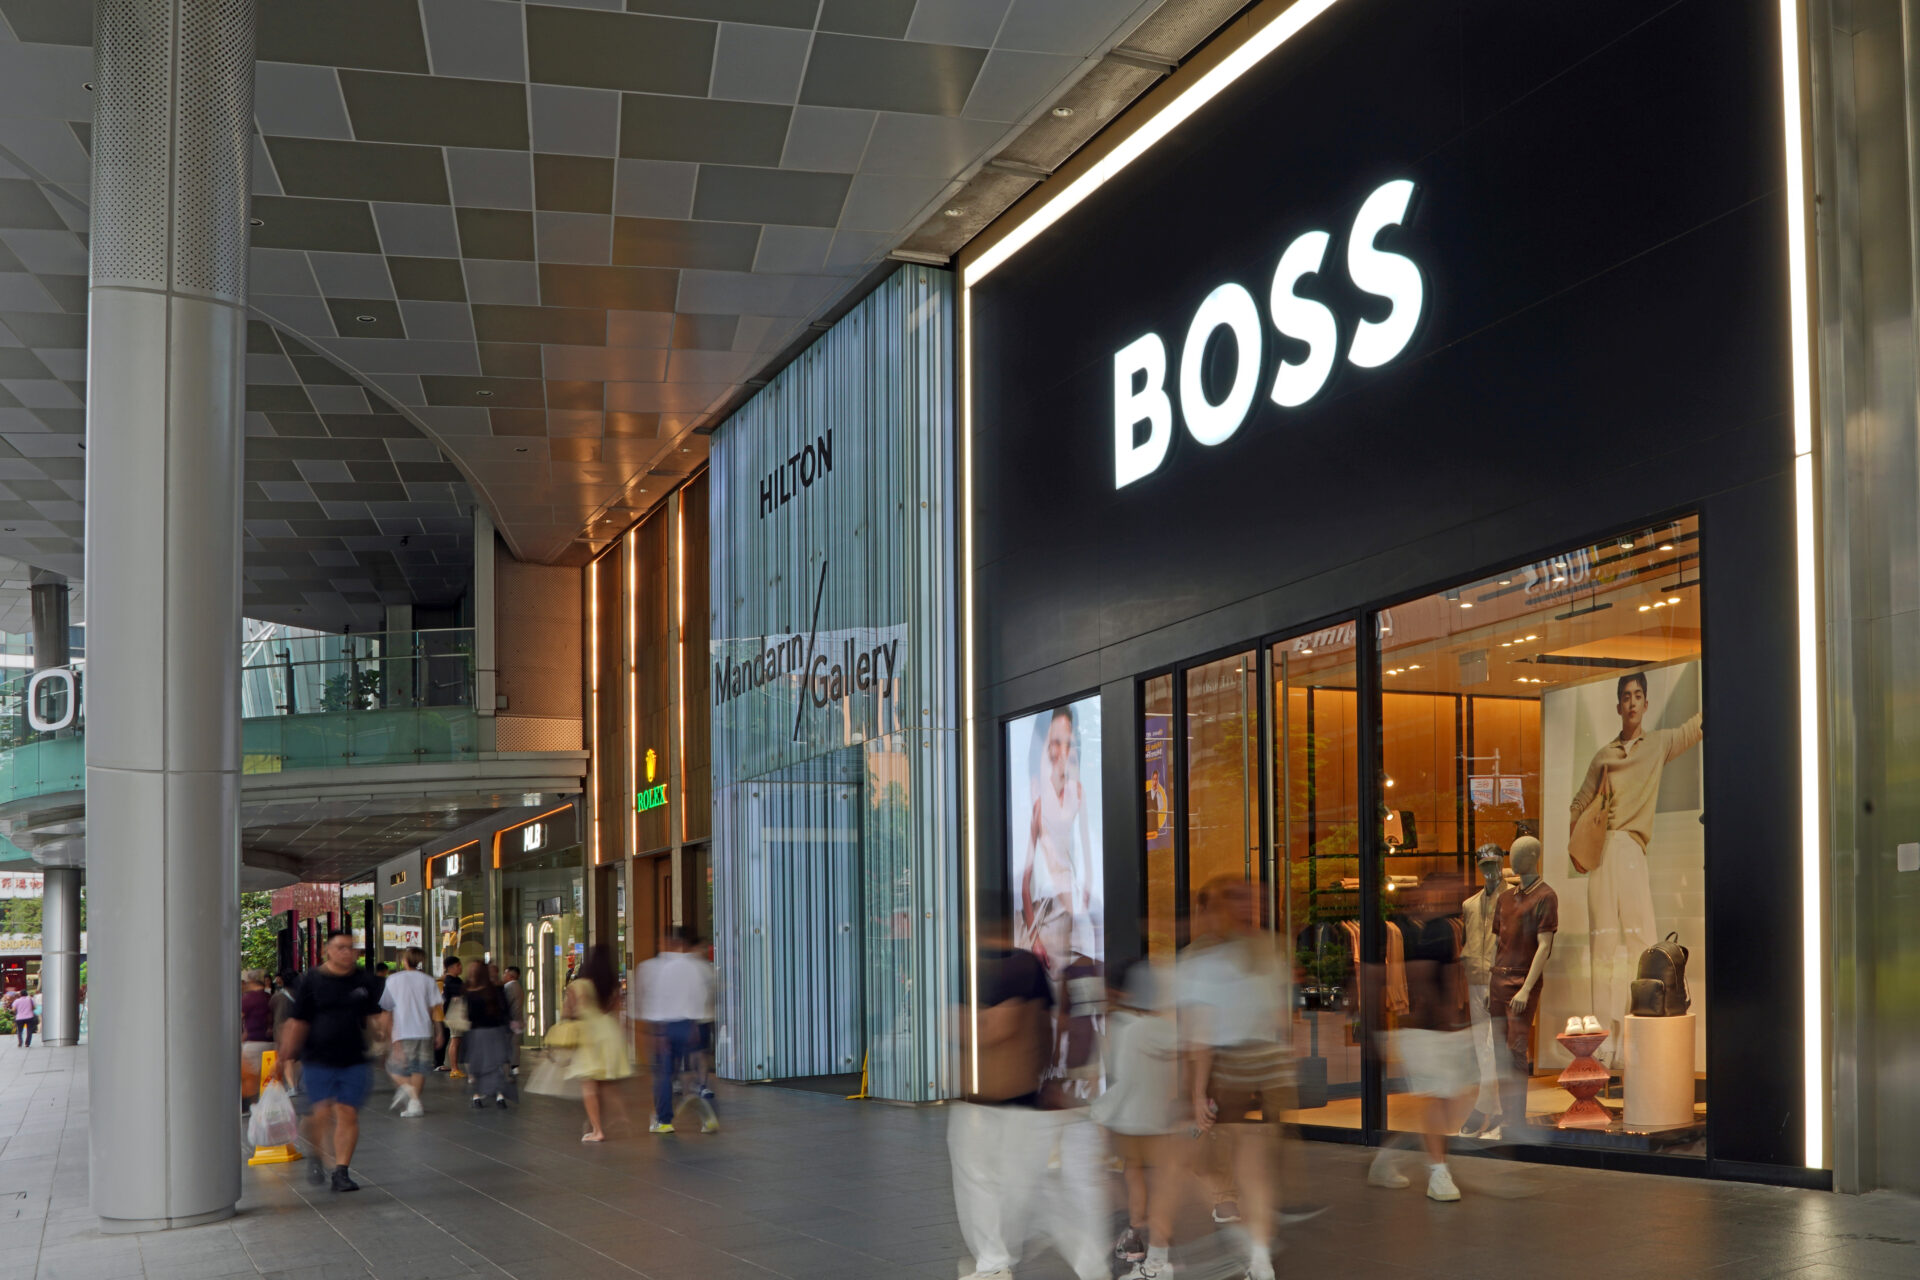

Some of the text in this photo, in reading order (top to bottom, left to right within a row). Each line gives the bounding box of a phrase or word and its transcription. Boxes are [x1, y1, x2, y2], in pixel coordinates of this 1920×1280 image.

[1114, 179, 1423, 490] BOSS
[760, 428, 832, 519] HILTON
[715, 625, 898, 708] Mandarin Gallery
[523, 826, 542, 853] MLB
[637, 784, 668, 813] ROLEX
